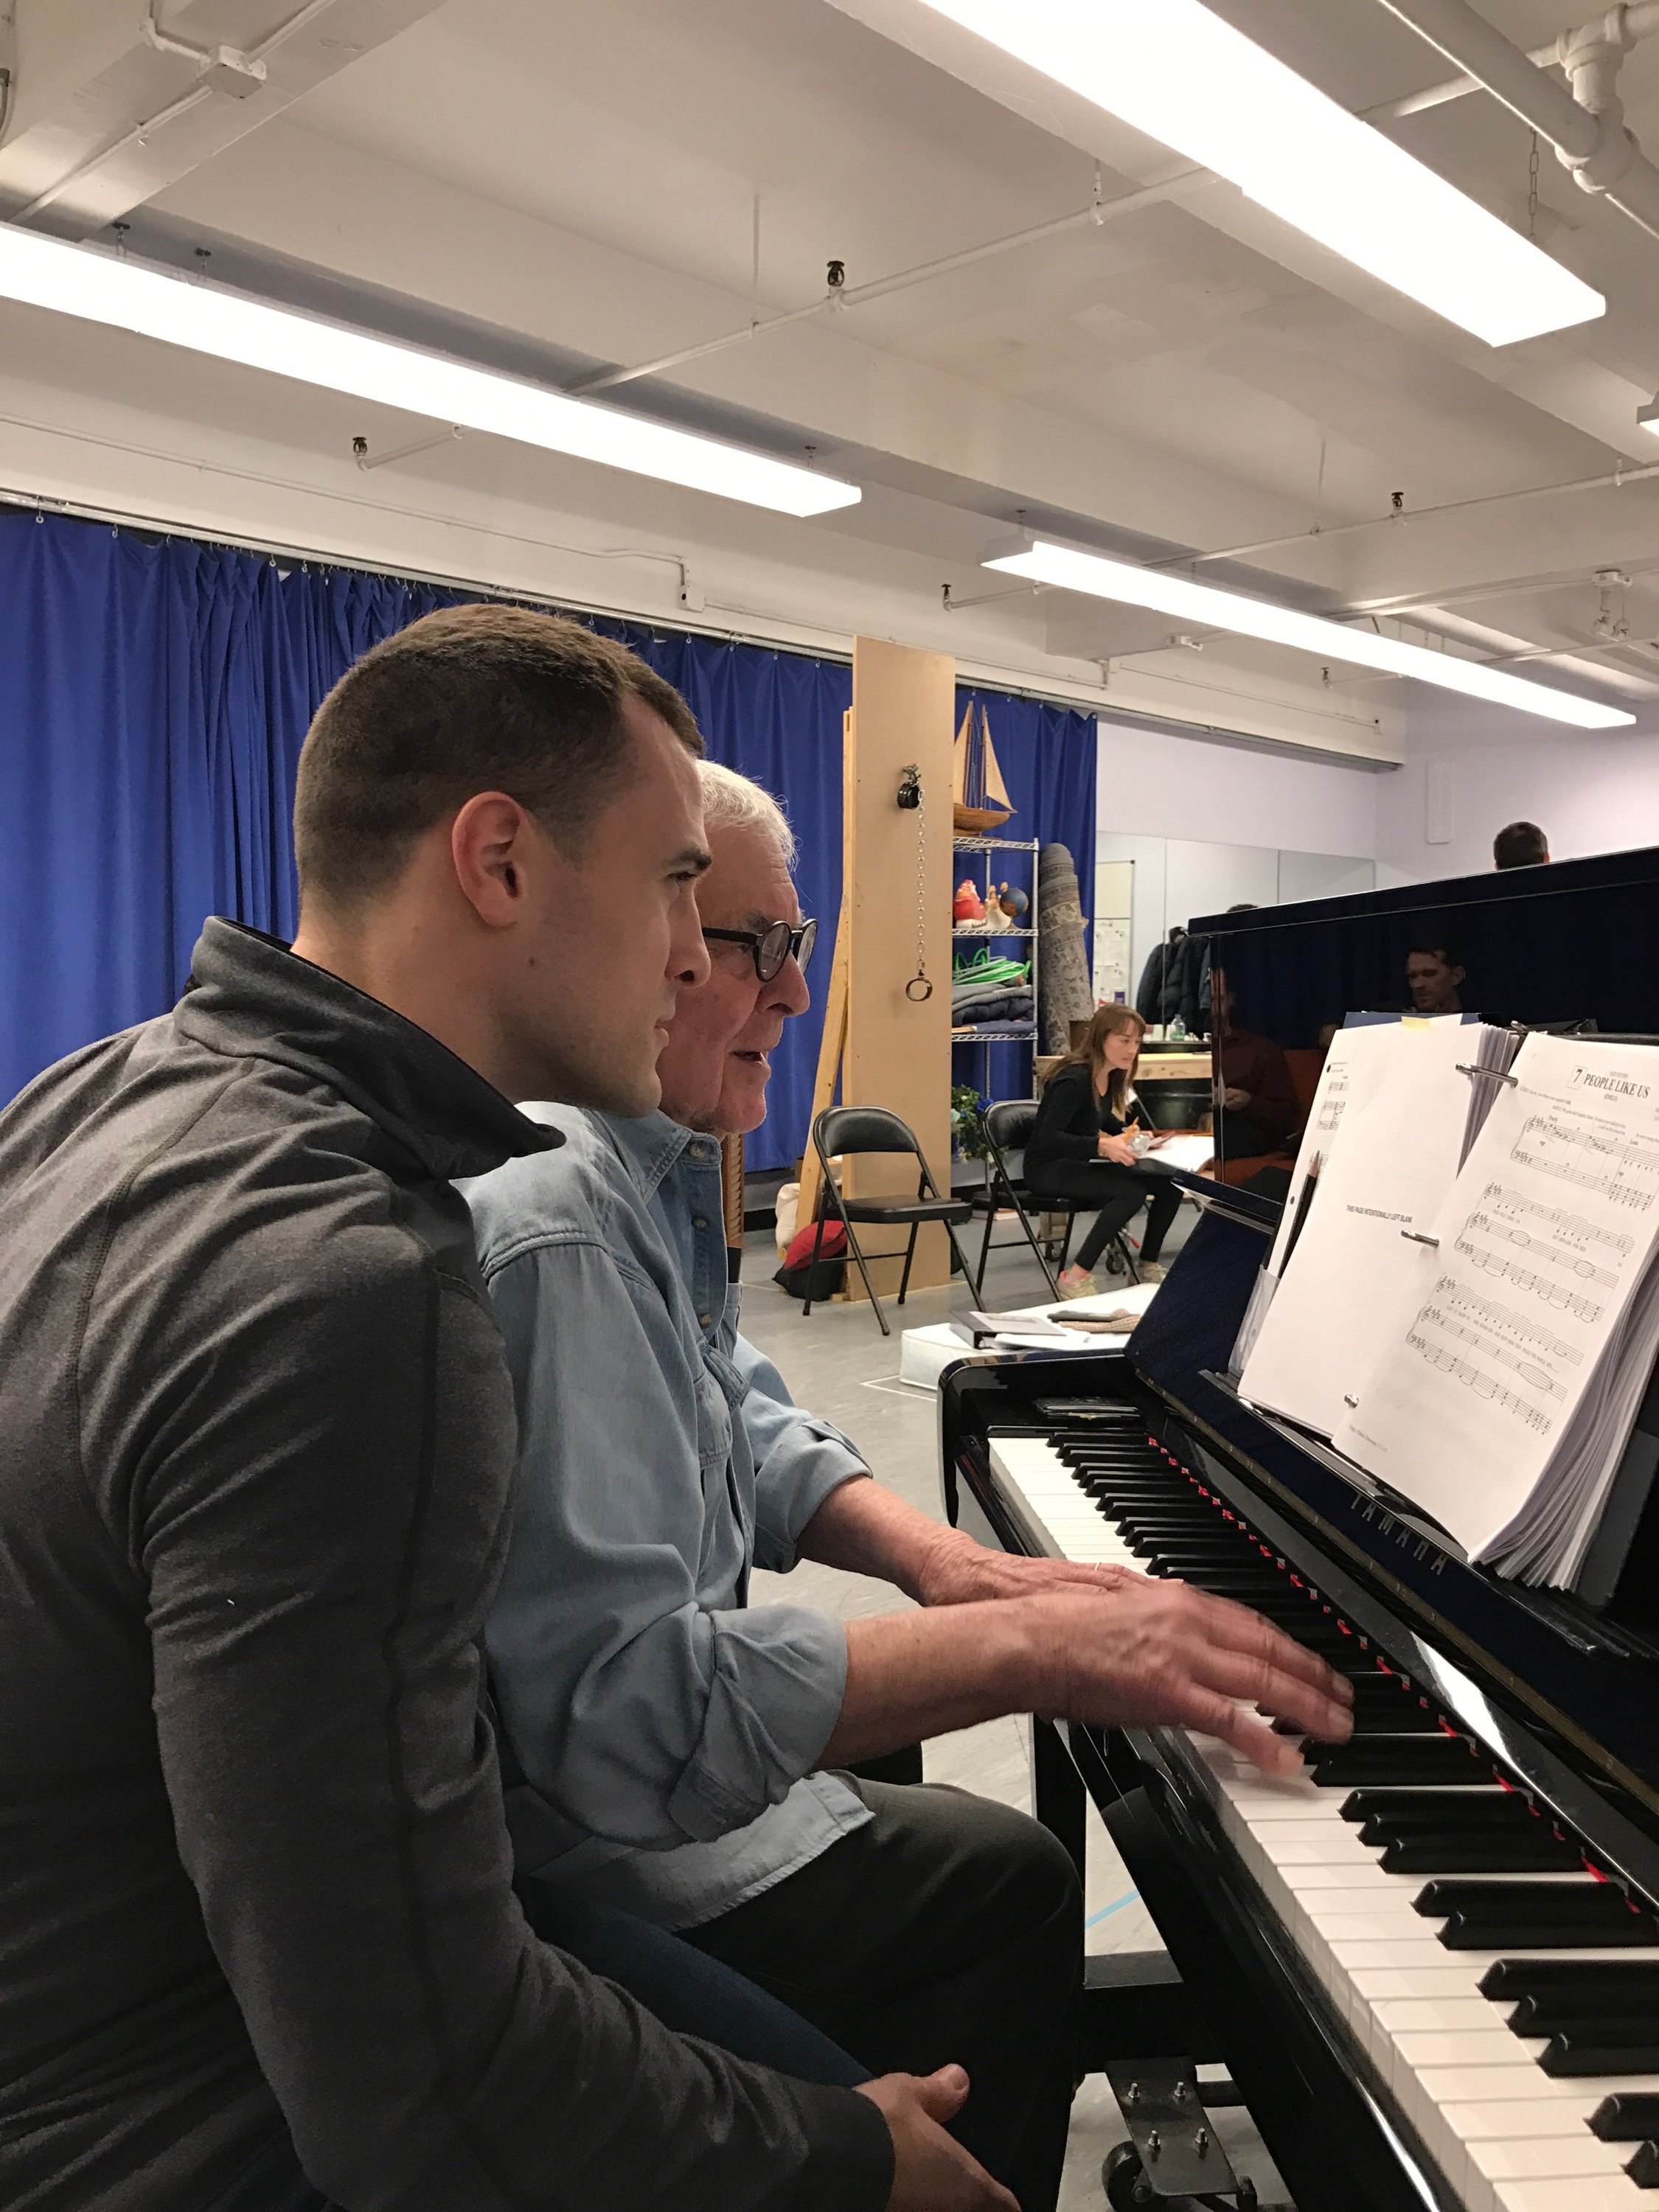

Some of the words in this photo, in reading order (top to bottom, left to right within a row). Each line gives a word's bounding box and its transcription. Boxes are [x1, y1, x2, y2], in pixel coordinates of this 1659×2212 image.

[1573, 1068, 1583, 1083] 7
[1583, 1073, 1616, 1091] PEOPLE
[1614, 1079, 1638, 1096] LIKE
[1636, 1085, 1651, 1099] US
[1346, 1204, 1355, 1213] THIS
[1354, 1206, 1365, 1214] PAGE
[1363, 1208, 1391, 1220] INTENTIONALLY
[1391, 1212, 1401, 1221] LEFT
[1399, 1214, 1413, 1223] BLANK
